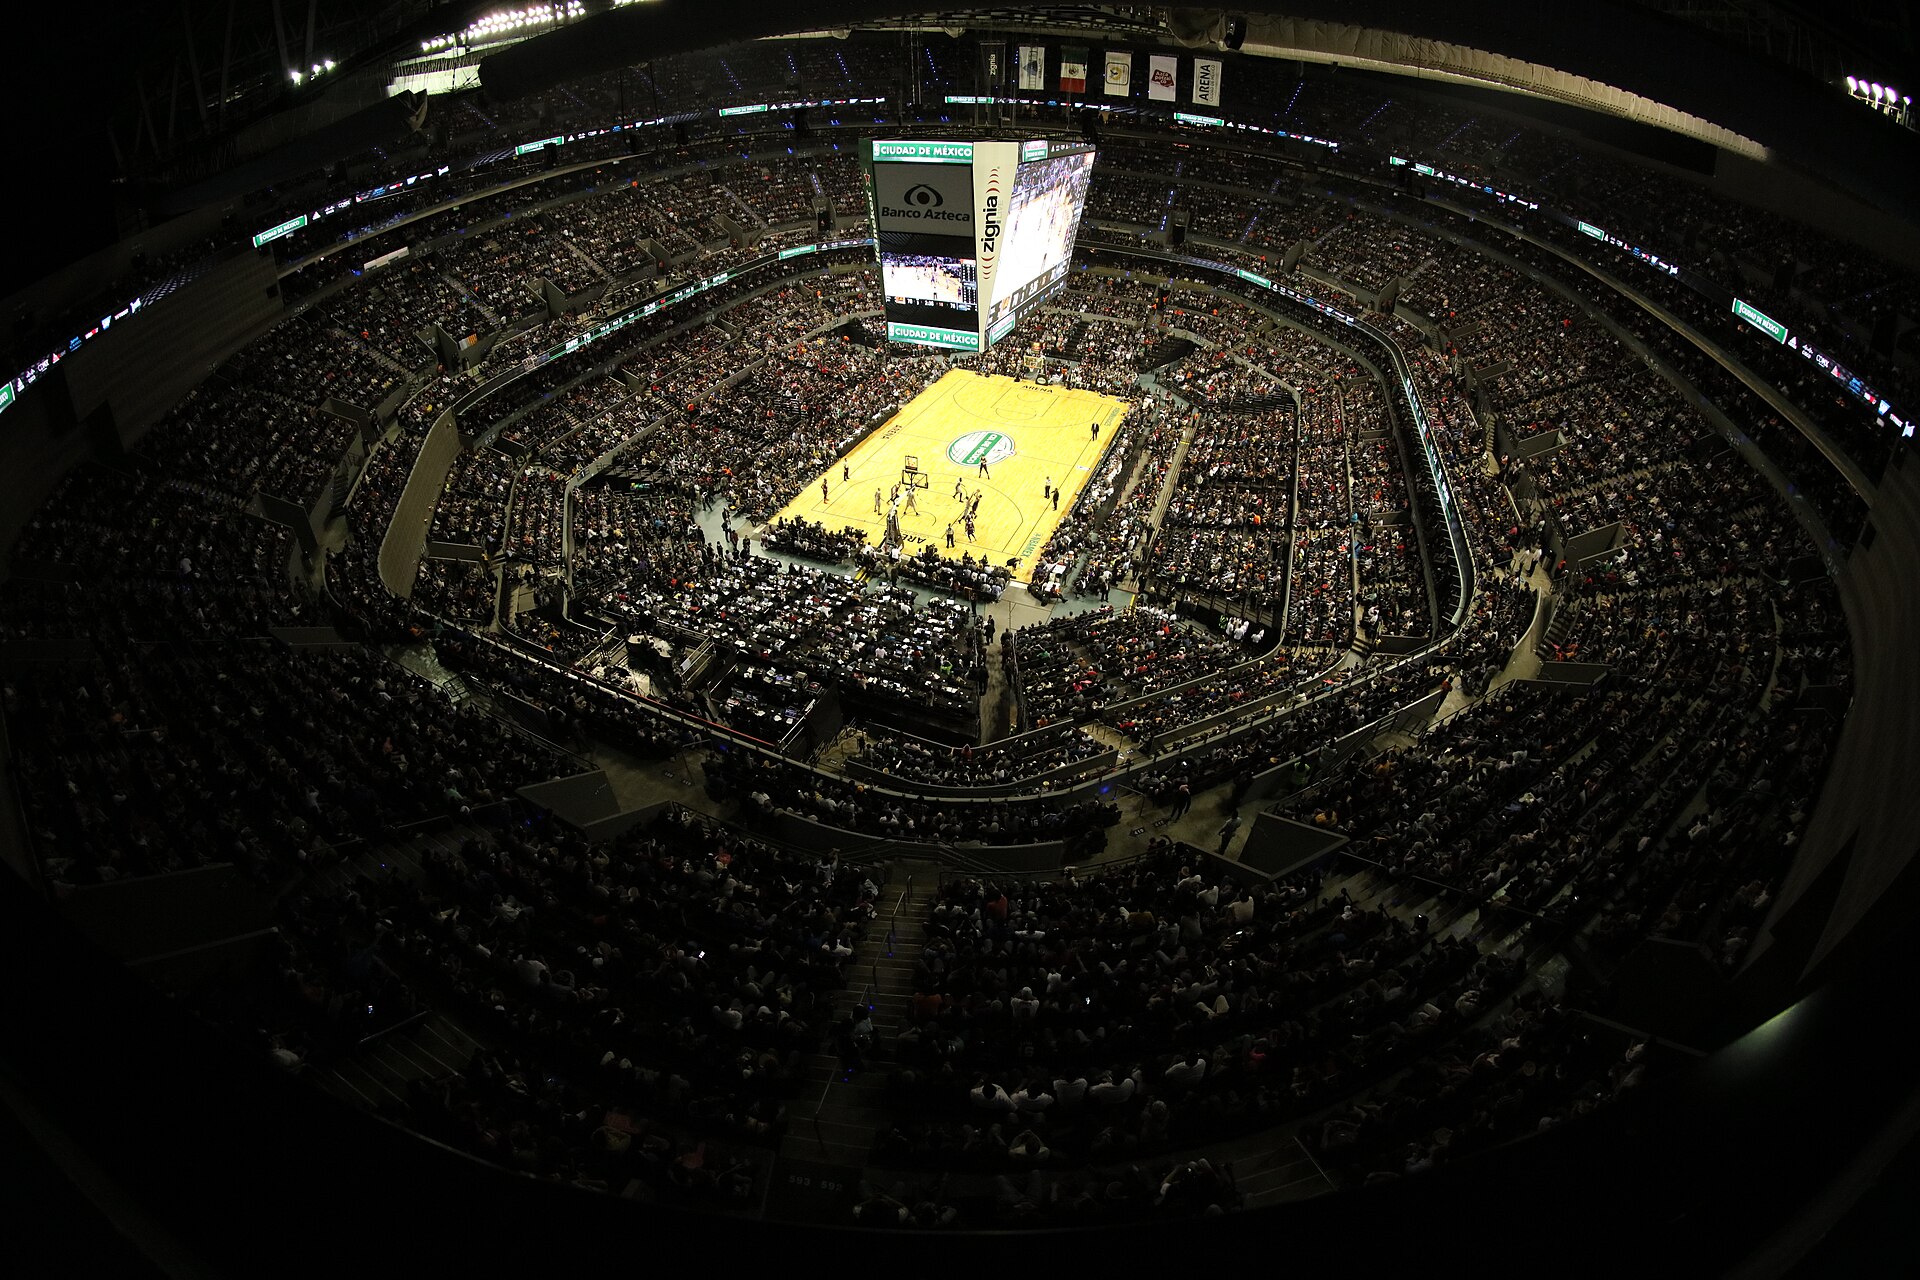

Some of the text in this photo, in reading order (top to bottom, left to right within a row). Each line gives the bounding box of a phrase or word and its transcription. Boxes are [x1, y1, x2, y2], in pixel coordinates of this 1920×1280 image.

[1199, 64, 1211, 101] ARENA
[881, 145, 972, 156] CIUDAD DE MÉXICO
[881, 206, 970, 222] Banco Azteca
[981, 195, 1000, 252] zignia
[895, 328, 978, 345] CIUDAD DE MÉXICO
